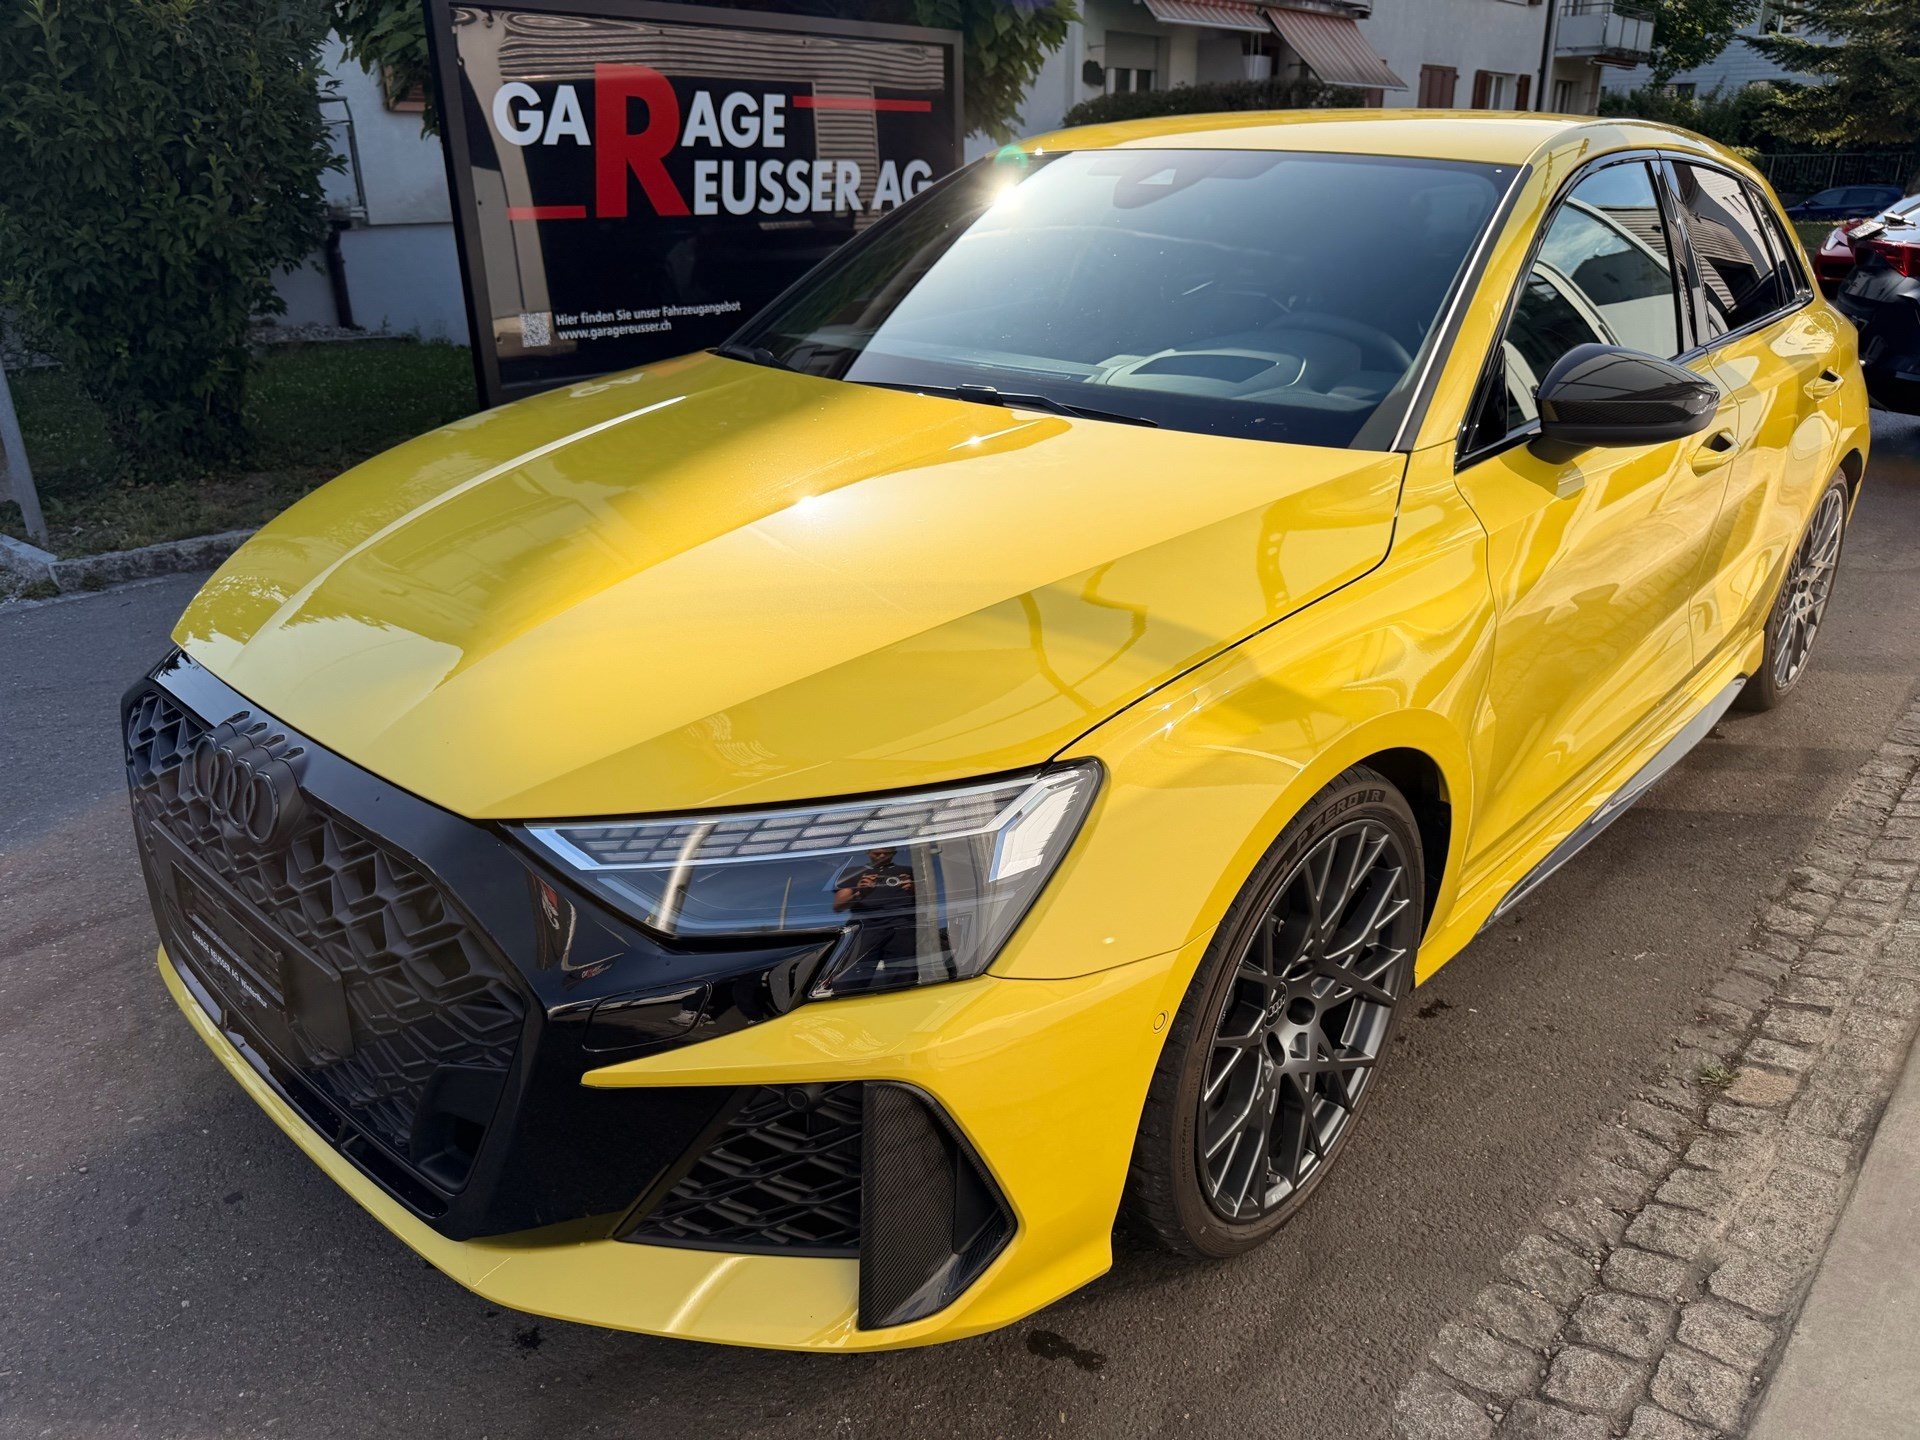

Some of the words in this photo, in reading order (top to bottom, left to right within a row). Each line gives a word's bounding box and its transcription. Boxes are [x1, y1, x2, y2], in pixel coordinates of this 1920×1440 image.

[873, 159, 935, 213] AG
[555, 312, 578, 327] Hier
[580, 311, 615, 325] finden
[615, 308, 632, 321] Sie
[633, 308, 661, 320] unser
[662, 300, 742, 318] Fahrzeugangebot
[557, 319, 673, 341] www.garagereusser.ch
[1311, 792, 1360, 835] ZERO
